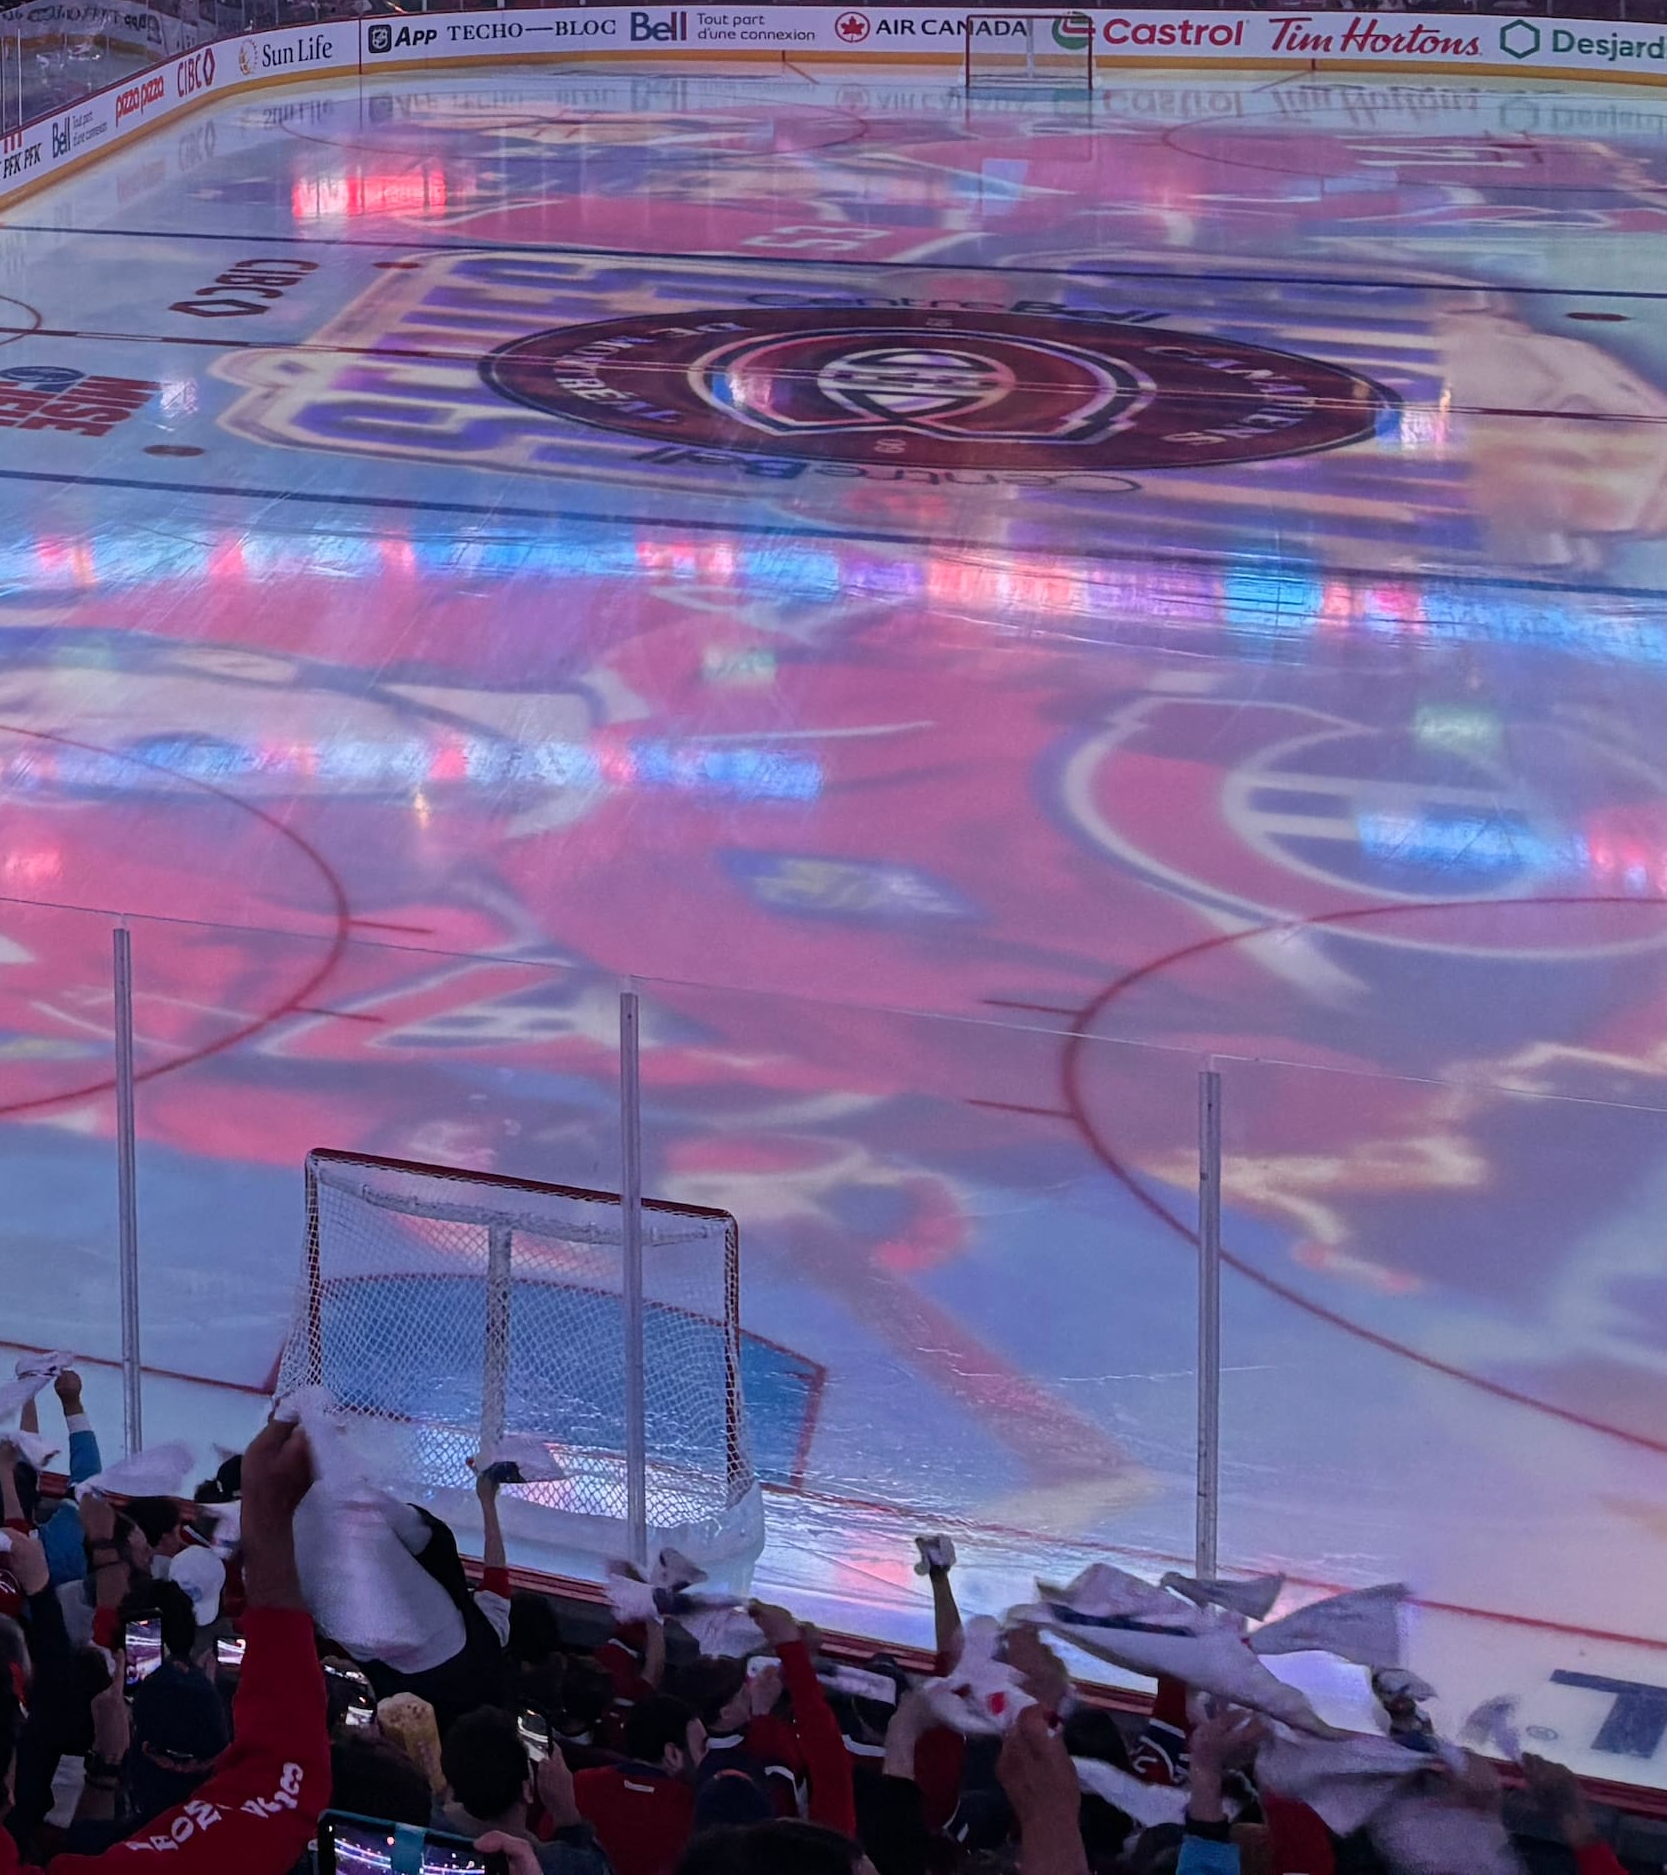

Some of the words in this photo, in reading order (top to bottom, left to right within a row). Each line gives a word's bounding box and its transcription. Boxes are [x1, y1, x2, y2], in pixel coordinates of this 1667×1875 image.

[629, 11, 687, 42] Bell
[697, 13, 728, 26] Tout
[732, 13, 765, 29] part
[697, 28, 737, 41] d'une
[740, 29, 816, 42] connexion
[875, 18, 915, 36] AIR
[921, 18, 1027, 37] CANADA
[1102, 16, 1244, 48] Castrol
[1268, 16, 1335, 53] Tim
[1338, 17, 1480, 57] Hortons
[261, 43, 295, 68] Sun
[298, 34, 333, 65] Life
[178, 54, 203, 98] CIBC
[116, 86, 139, 128] pizza
[140, 76, 164, 115] pizza
[52, 115, 71, 158] Bell
[3, 152, 23, 179] PFK
[24, 142, 42, 170] PFK
[194, 258, 320, 299] CIBC
